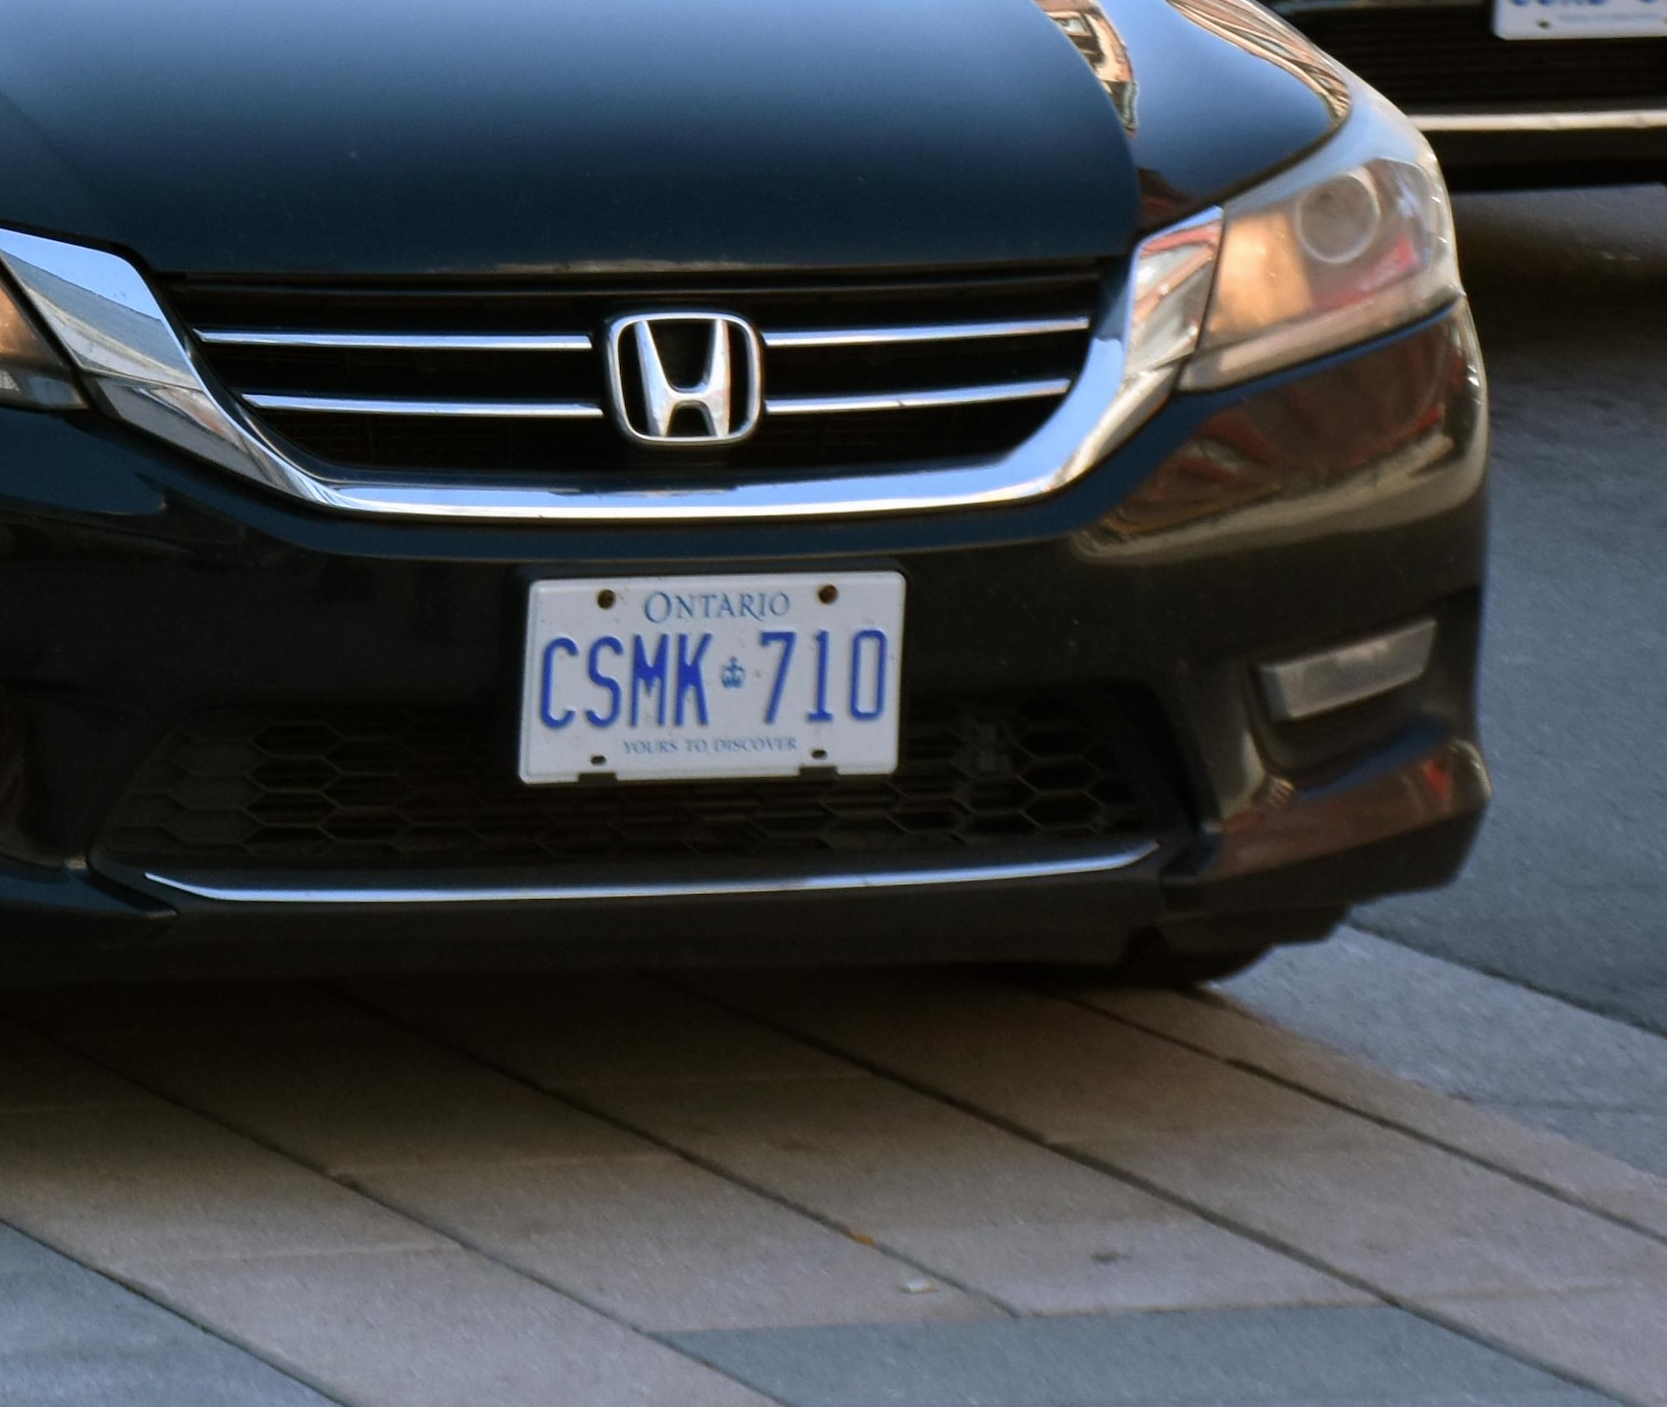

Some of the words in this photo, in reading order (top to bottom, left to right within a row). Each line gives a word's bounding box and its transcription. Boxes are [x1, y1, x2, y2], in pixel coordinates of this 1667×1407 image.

[644, 591, 791, 624] ONTARIO
[540, 632, 713, 730] CSMK
[761, 629, 888, 725] 710
[623, 740, 679, 755] YOURS
[685, 739, 708, 754] TO
[713, 735, 798, 752] DISCOVER
